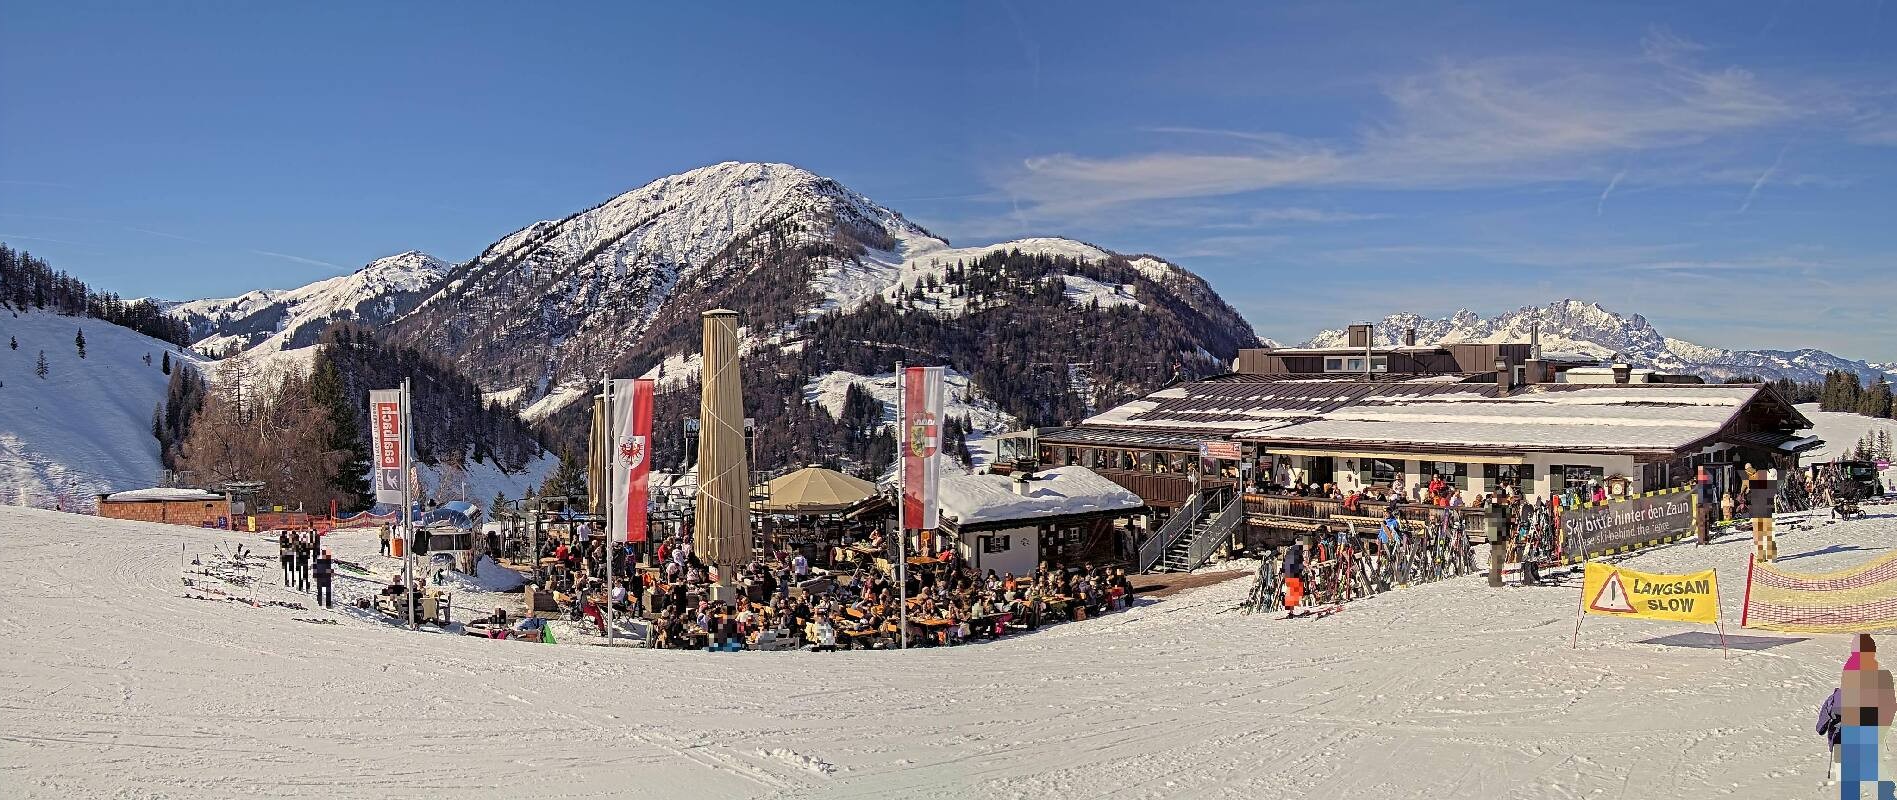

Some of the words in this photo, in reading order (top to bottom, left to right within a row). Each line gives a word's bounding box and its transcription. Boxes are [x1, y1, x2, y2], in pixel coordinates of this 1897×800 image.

[1566, 518, 1583, 536] Ski
[1585, 513, 1613, 532] bitte
[1614, 508, 1645, 527] hinter
[1647, 504, 1664, 520] den
[1666, 501, 1689, 516] Zaun
[1596, 531, 1607, 544] ski
[1608, 525, 1636, 542] behind
[1637, 523, 1650, 536] the
[1633, 578, 1710, 596] LANGSAM
[1647, 598, 1695, 613] SLOW
